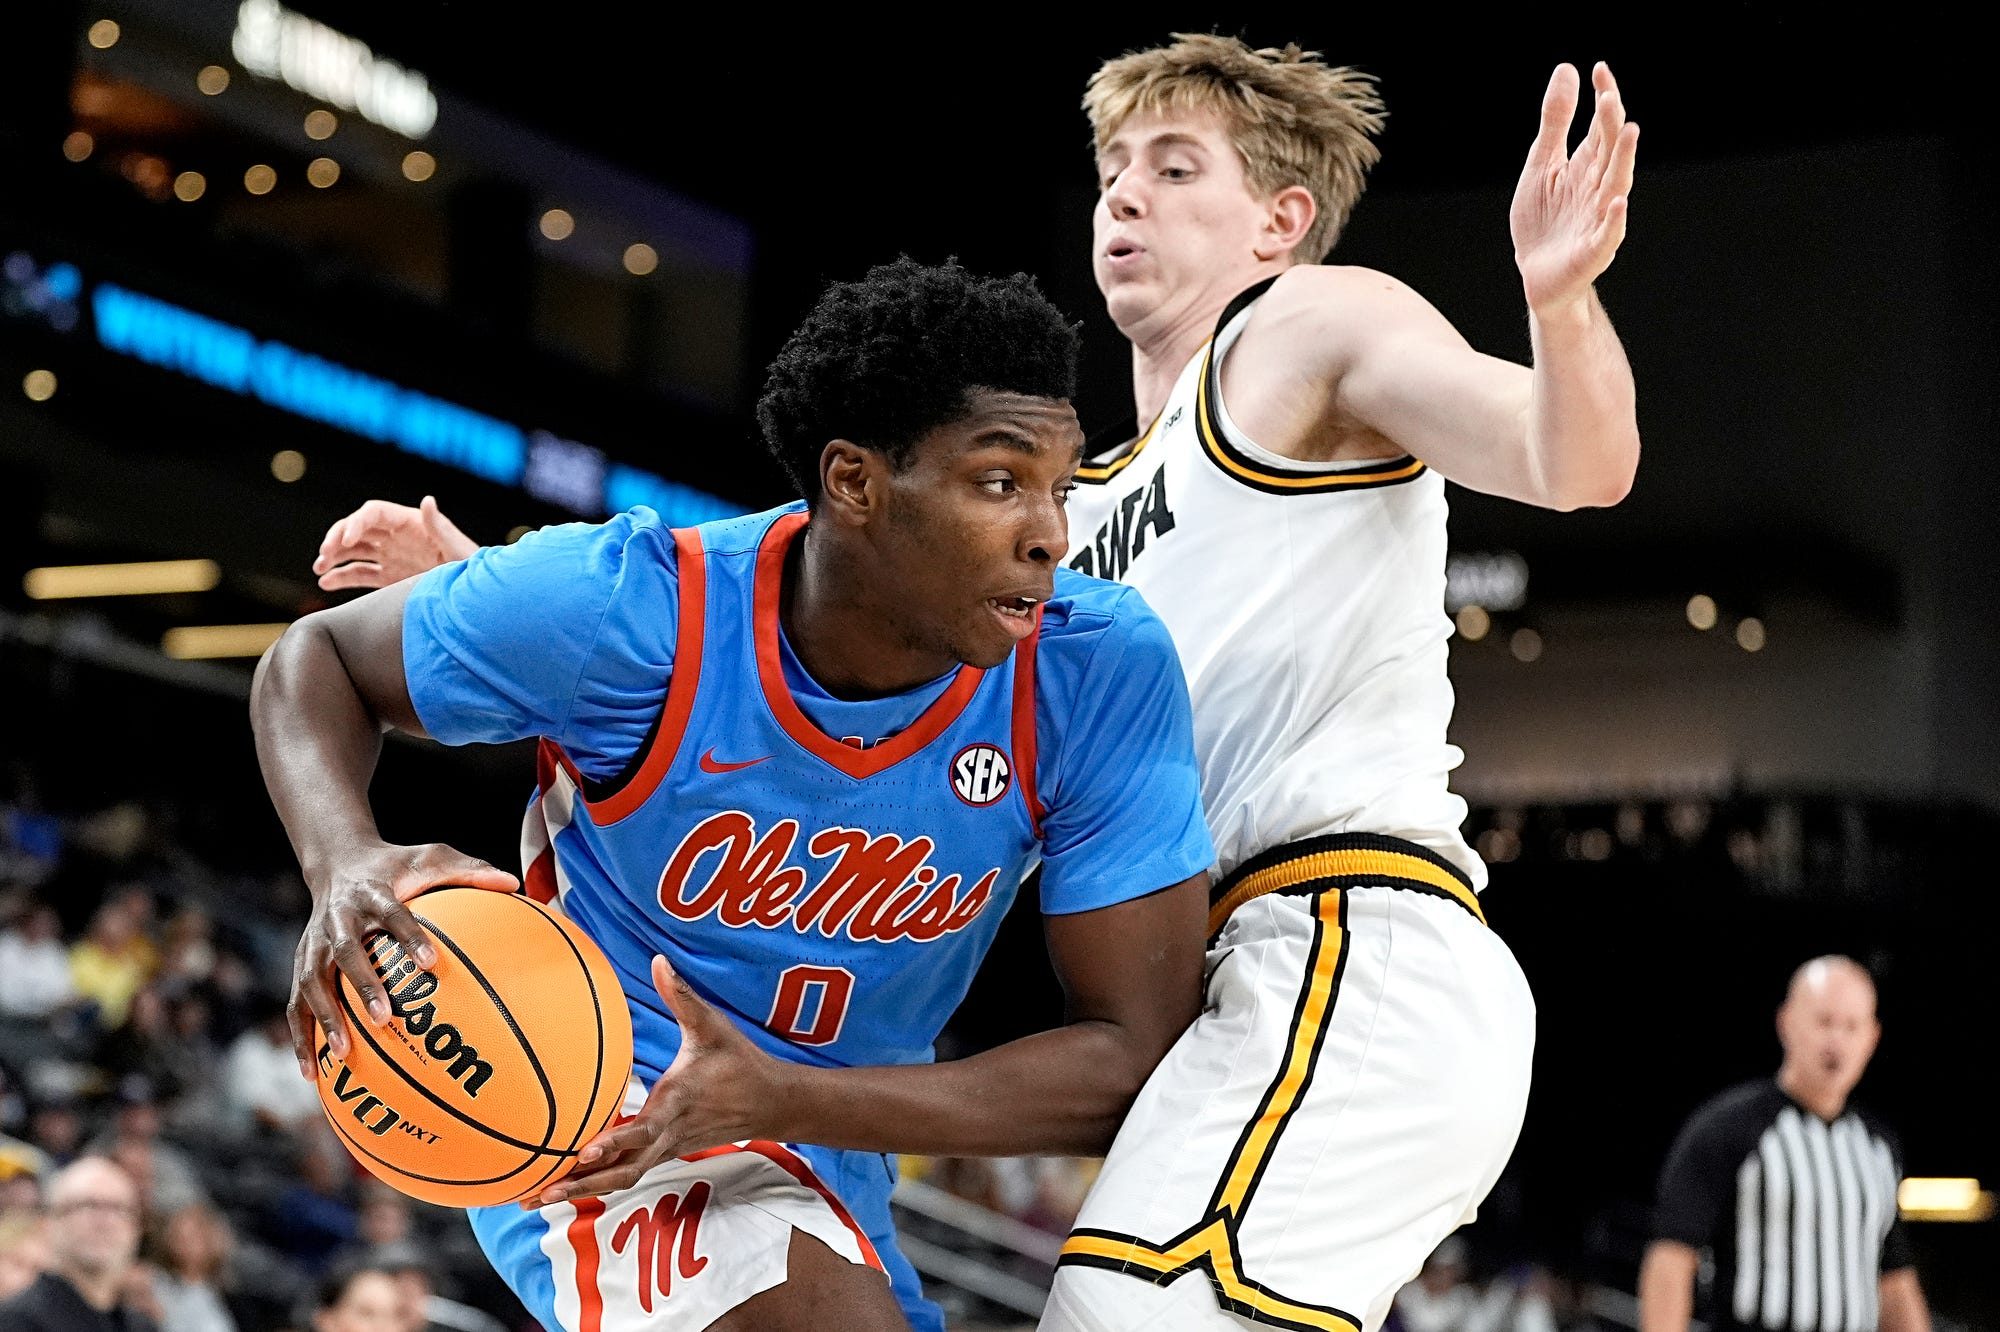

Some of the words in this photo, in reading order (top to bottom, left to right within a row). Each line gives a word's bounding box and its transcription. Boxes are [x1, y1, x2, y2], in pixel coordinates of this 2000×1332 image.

[954, 747, 1009, 802] SEC
[657, 810, 807, 929] Ole
[792, 827, 1001, 943] Miss
[387, 1020, 409, 1044] GAME
[408, 1044, 428, 1066] BALL
[765, 964, 856, 1047] 0
[317, 1041, 401, 1136] EVO
[398, 1120, 442, 1145] NXT
[611, 1180, 713, 1317] M
